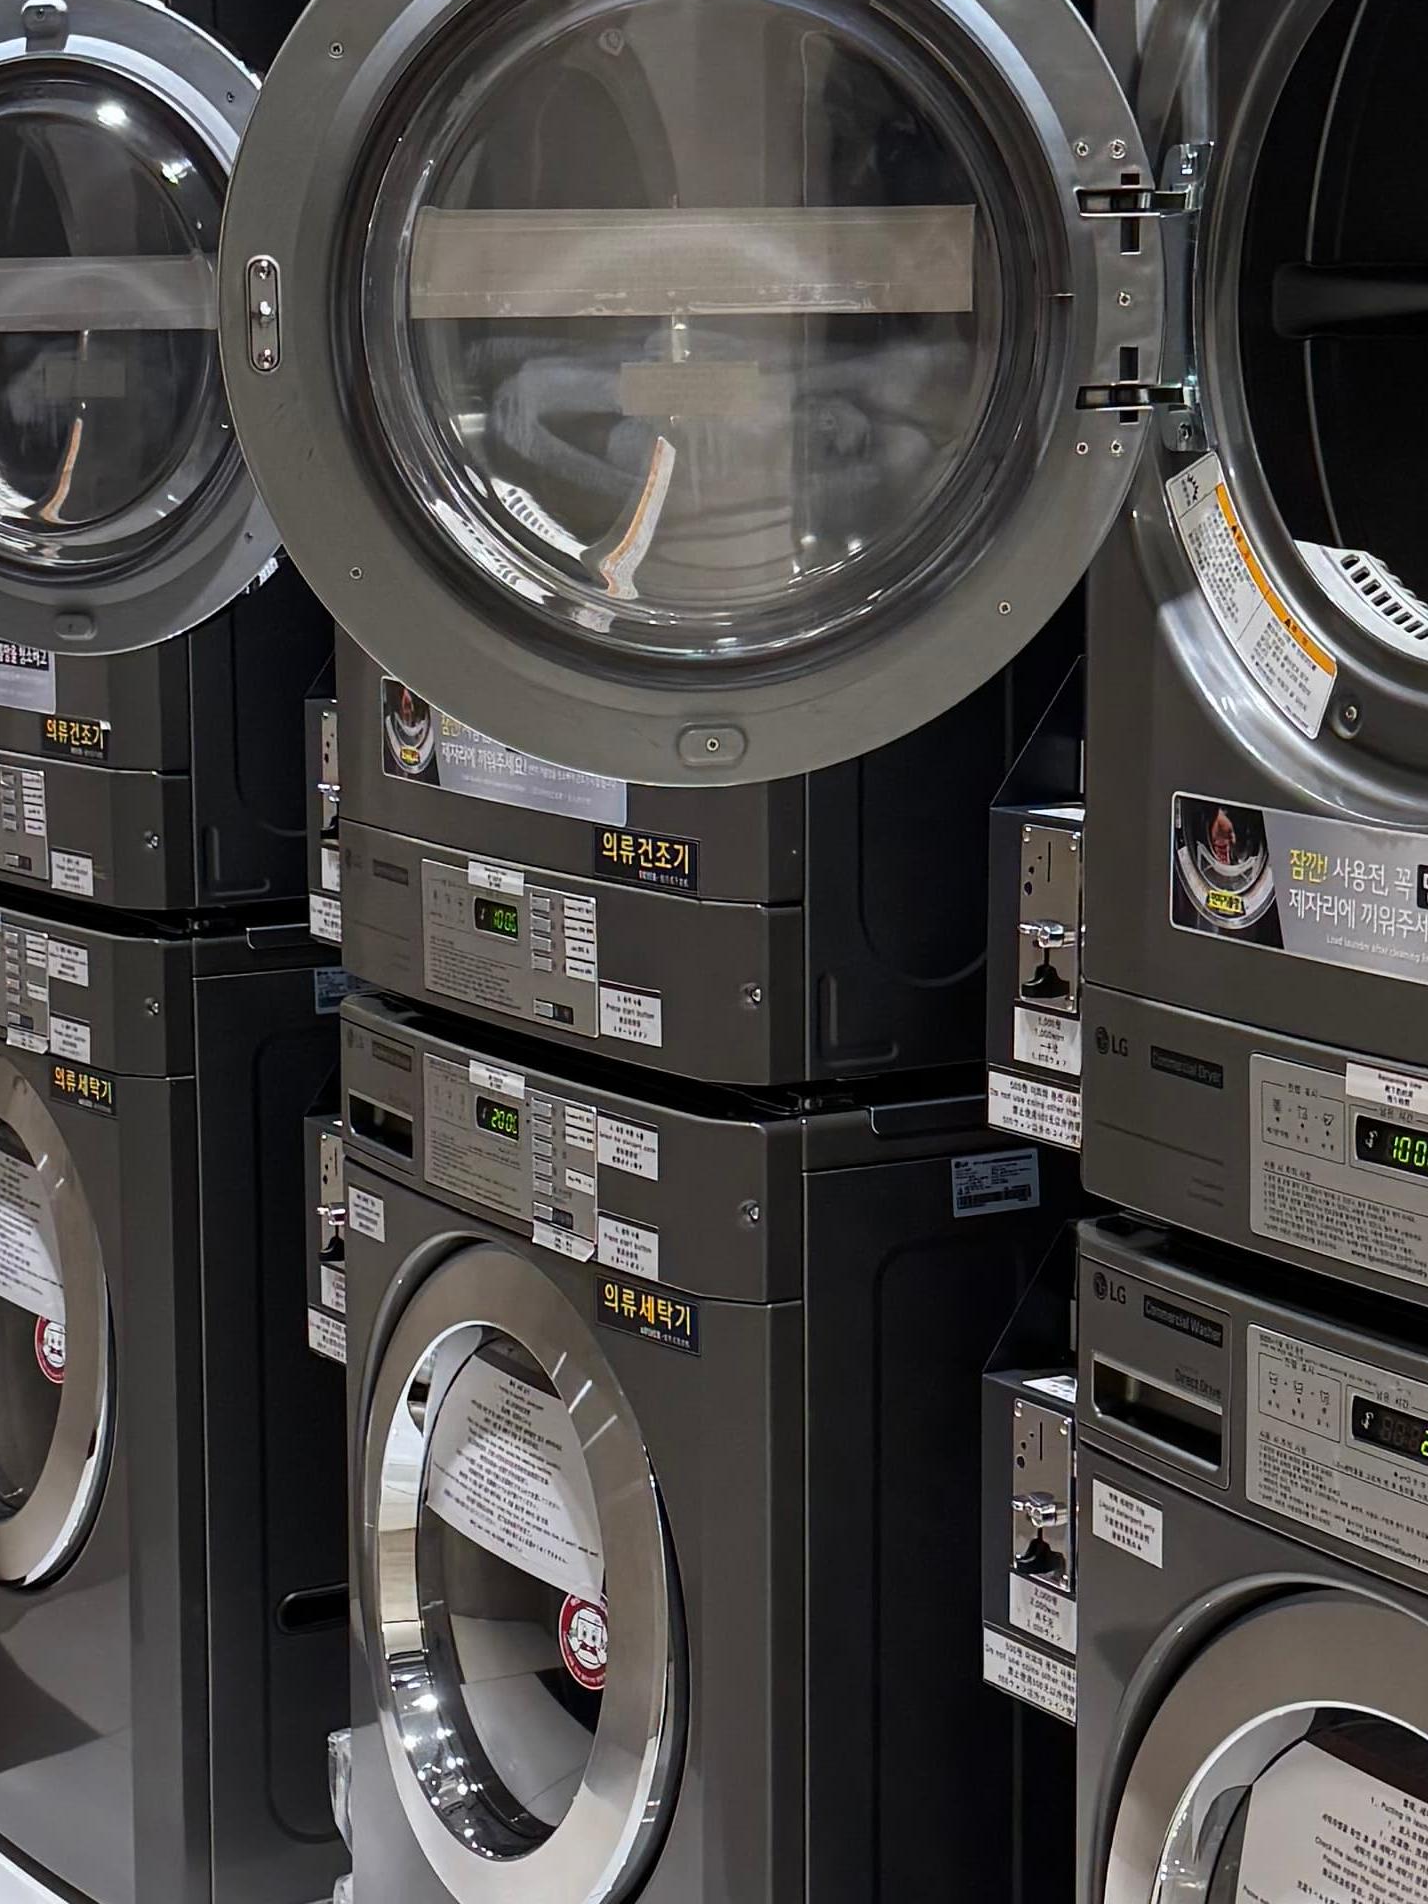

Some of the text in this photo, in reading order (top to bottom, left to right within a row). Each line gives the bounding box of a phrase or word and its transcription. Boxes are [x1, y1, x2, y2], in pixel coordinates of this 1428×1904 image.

[46, 717, 104, 750] 의류건조기
[602, 832, 690, 875] 의류건조기
[1290, 849, 1328, 884] 잠깐!
[1394, 866, 1415, 899] 꼭
[1289, 887, 1357, 929] 제자리에
[1111, 1035, 1128, 1057] LG
[54, 1065, 112, 1103] 의류세탁기
[603, 1283, 691, 1336] 의류세탁기
[1109, 1279, 1127, 1305] LG
[1145, 1296, 1222, 1342] Commercial Washer
[1381, 1800, 1402, 1821] Putting
[1404, 1813, 1411, 1824] in
[1314, 1834, 1332, 1852] Check
[1334, 1846, 1343, 1858] the
[1345, 1852, 1368, 1872] laundry
[1369, 1865, 1385, 1881] label
[1387, 1874, 1400, 1888] and
[1401, 1881, 1412, 1896] put
[1414, 1888, 1421, 1899] in
[1379, 1841, 1397, 1860] 세탁기
[1242, 1882, 1258, 1899] Please
[1322, 1852, 1342, 1872] Please
[1342, 1864, 1358, 1882] open
[1360, 1874, 1370, 1886] the
[1372, 1880, 1387, 1895] door
[1388, 1888, 1404, 1904] after
